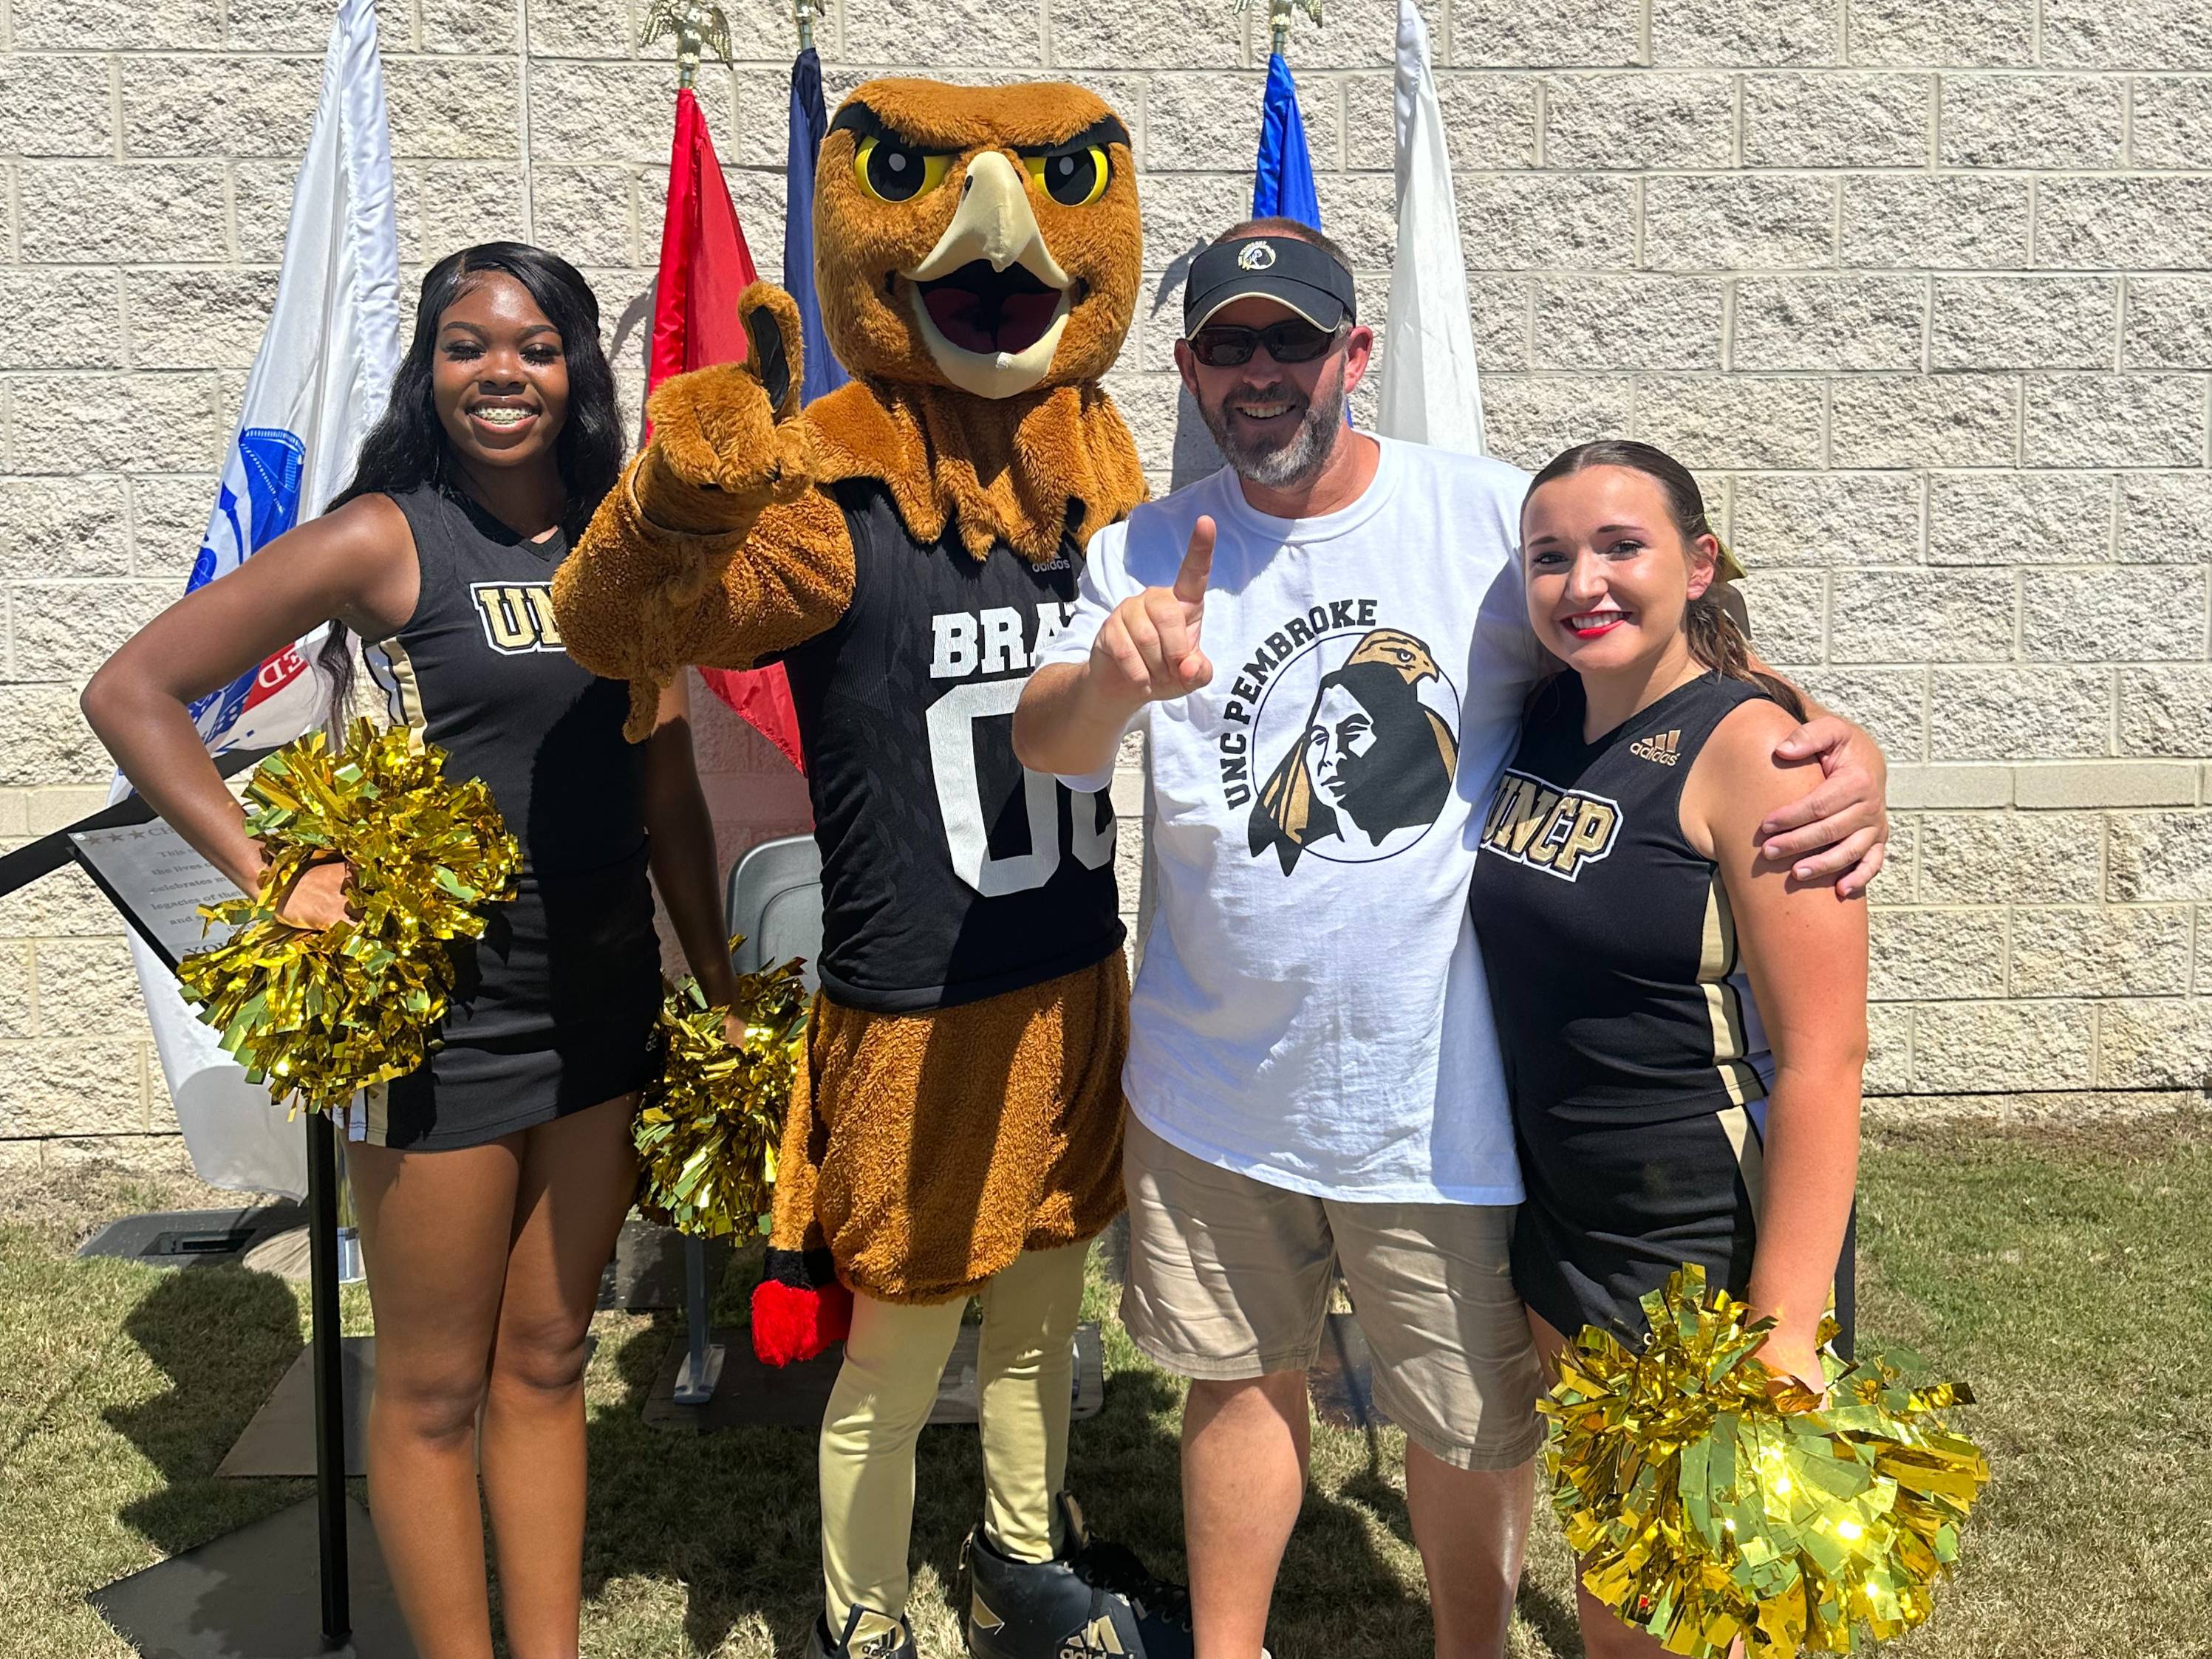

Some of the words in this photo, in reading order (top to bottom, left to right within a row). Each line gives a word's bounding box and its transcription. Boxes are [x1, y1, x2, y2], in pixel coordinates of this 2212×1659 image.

[929, 602, 1076, 679] BRA
[1223, 599, 1378, 725] PEMBROKE
[1630, 742, 1679, 766] adidas
[1220, 733, 1252, 810] UNC
[1479, 767, 1625, 883] UNCP
[174, 863, 202, 872] lives
[151, 878, 213, 892] celebrates
[151, 897, 201, 911] legacies
[203, 893, 216, 902] of
[169, 916, 192, 925] and
